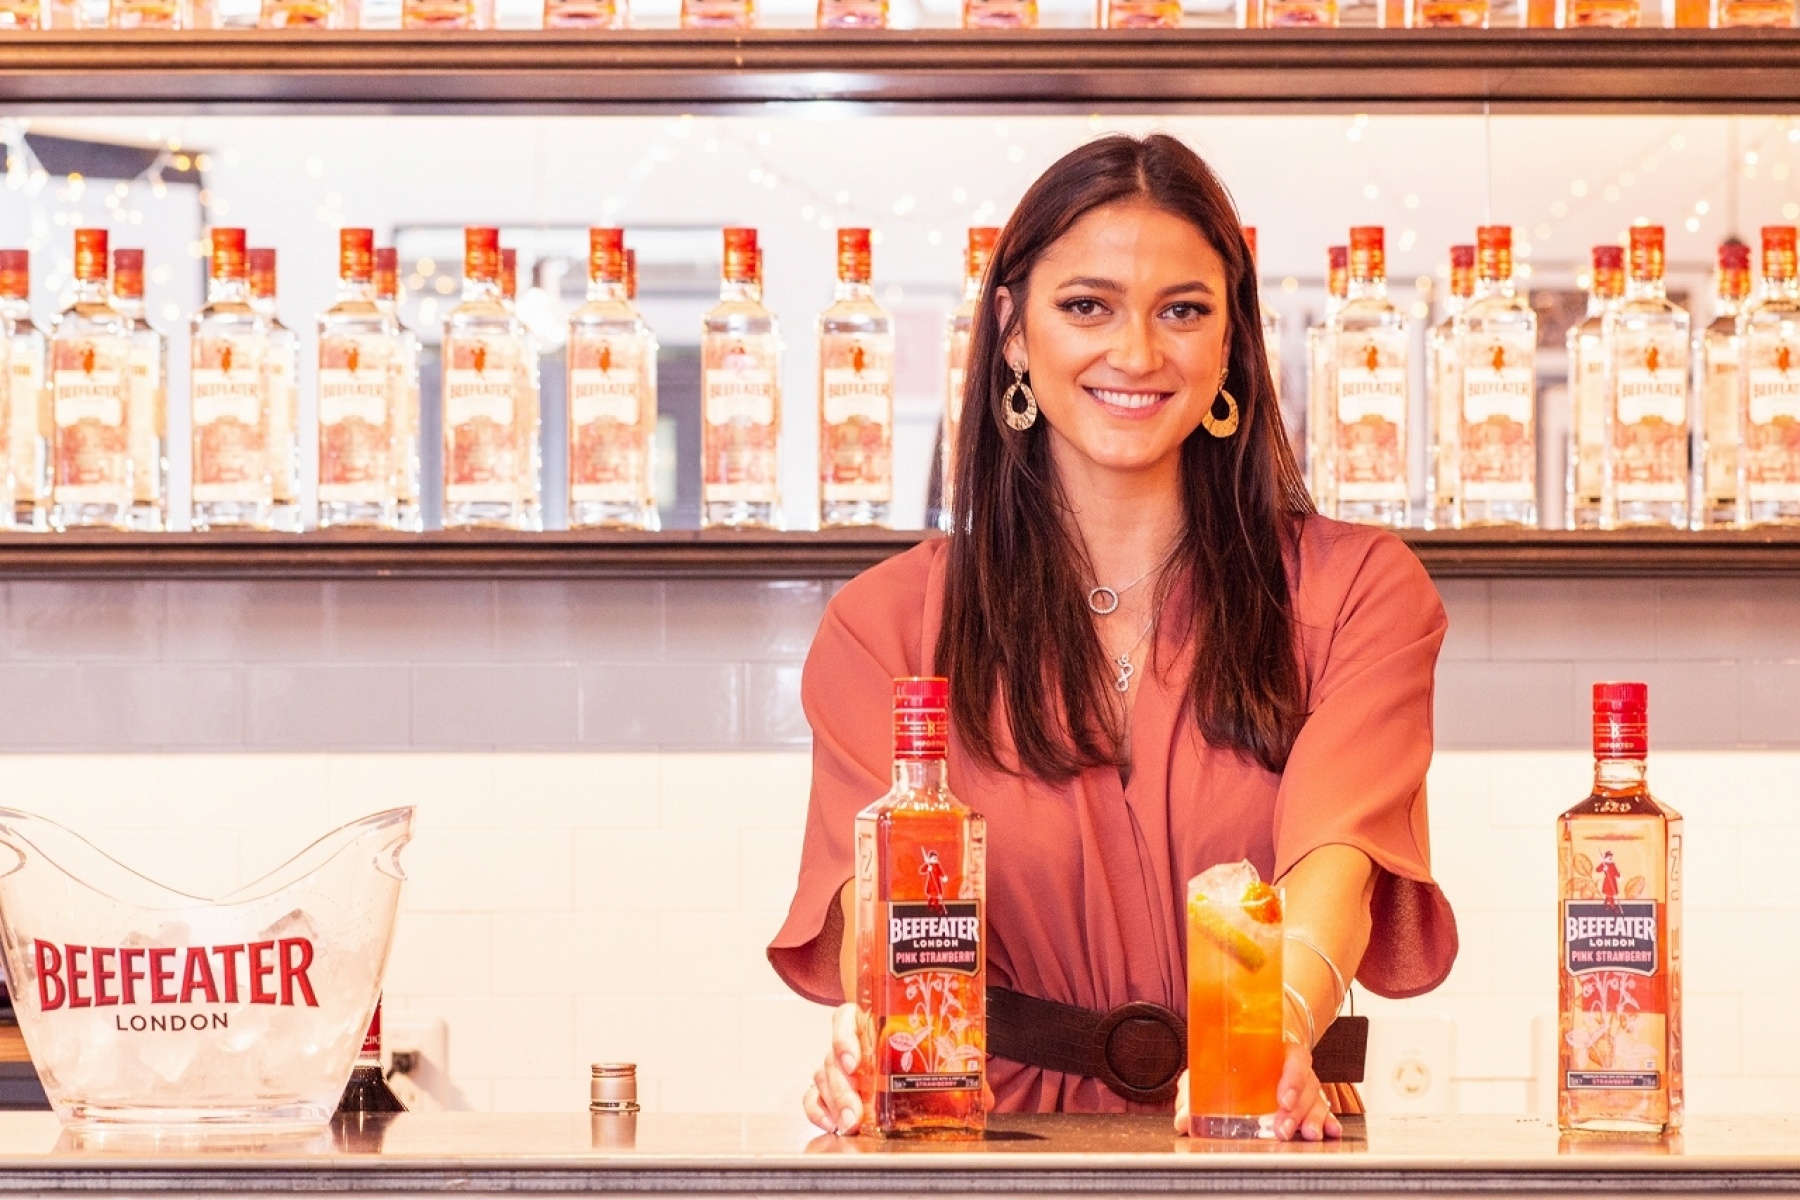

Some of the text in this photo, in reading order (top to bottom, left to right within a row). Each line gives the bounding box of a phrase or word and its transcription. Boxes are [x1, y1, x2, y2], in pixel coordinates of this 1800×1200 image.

[59, 383, 122, 401] BEEFEATER
[193, 383, 260, 400] BEEFEATER
[319, 383, 385, 400] BEEFEATER
[449, 383, 513, 400] BEEFEATER
[575, 382, 638, 400] BEEFEATER
[709, 382, 772, 400] BEEFEATER
[828, 382, 891, 400] BEEFEATER
[1342, 381, 1404, 399] BEEFEATER
[1467, 381, 1531, 399] BEEFEATER
[1622, 382, 1684, 400] BEEFEATER
[889, 916, 980, 944] BEEFEATER
[1565, 916, 1656, 942] BEEFEATER
[913, 939, 960, 949] LONDON
[1588, 938, 1635, 948] LONDON
[895, 951, 976, 964] PINK STRAWBERRY
[1571, 950, 1652, 962] PINK STRAWBERRY
[33, 937, 319, 1011] BEEFEATER
[115, 1012, 229, 1031] LONDON
